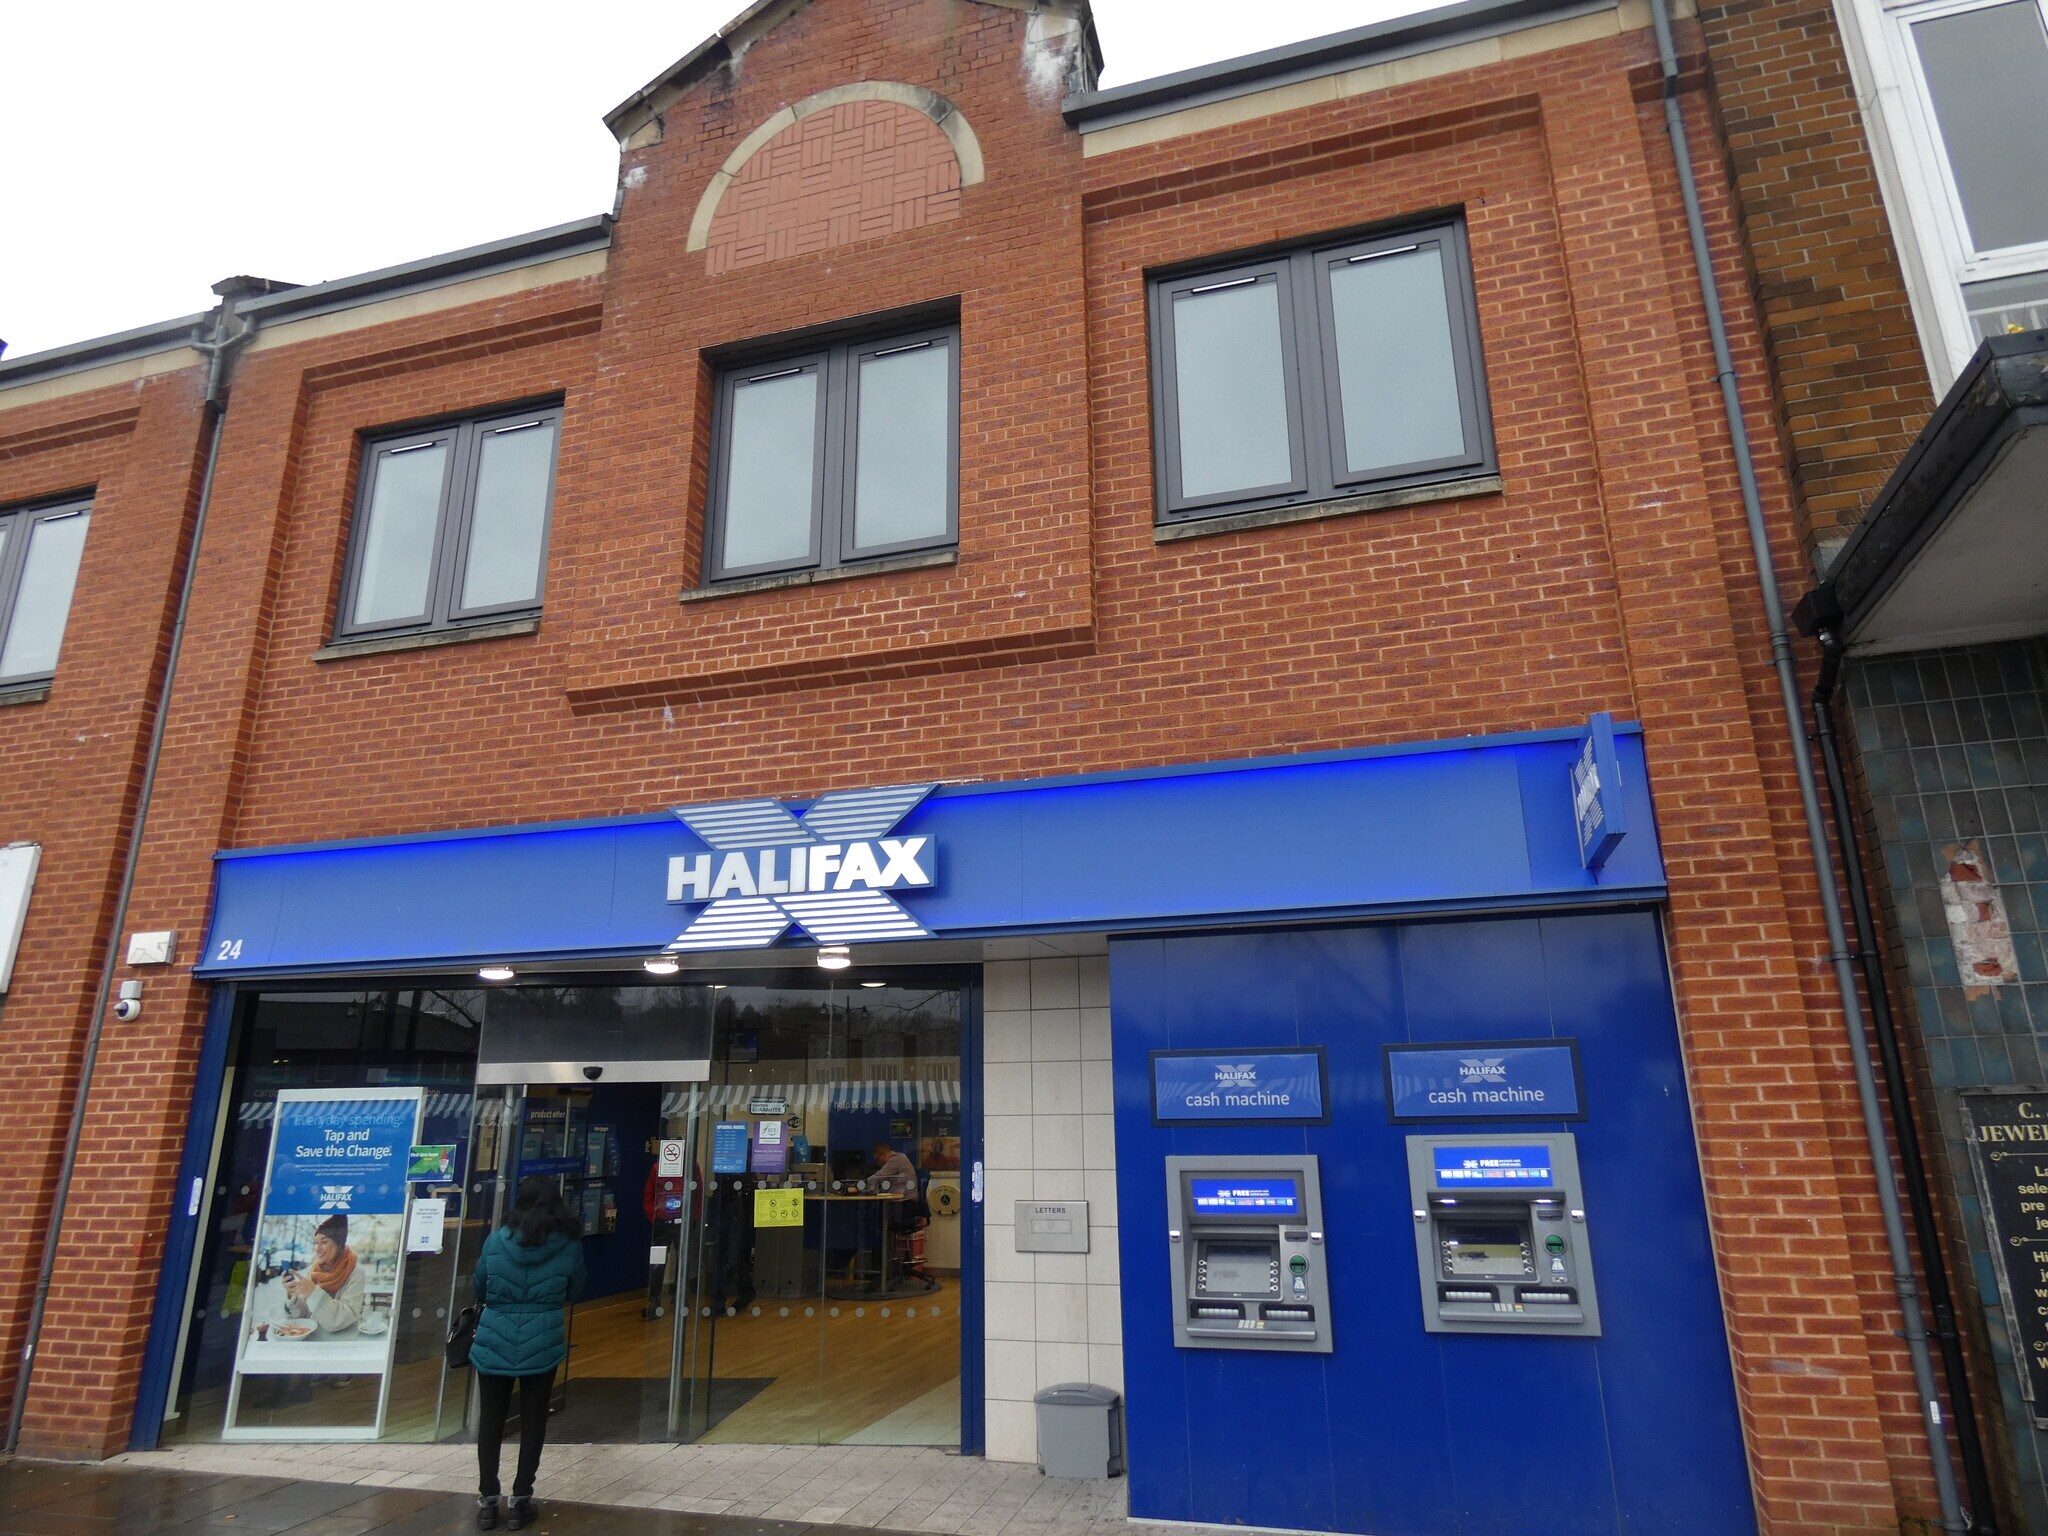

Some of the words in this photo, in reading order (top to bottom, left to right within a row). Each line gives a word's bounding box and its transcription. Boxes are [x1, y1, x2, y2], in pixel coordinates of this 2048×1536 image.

[667, 838, 930, 900] HALIFAX
[217, 939, 243, 961] 24
[1214, 1072, 1257, 1080] HALIFAX
[1459, 1066, 1506, 1075] HALIFAX
[1185, 1092, 1220, 1106] cash
[1225, 1091, 1290, 1106] machine
[1428, 1088, 1467, 1103] cash
[1472, 1086, 1545, 1102] machine
[293, 1114, 346, 1128] Everyday
[348, 1112, 403, 1128] spending.
[324, 1129, 345, 1144] Tap
[347, 1128, 371, 1141] and
[295, 1145, 324, 1157] Save
[325, 1145, 344, 1157] the
[1480, 1159, 1499, 1167] FREE
[320, 1193, 352, 1201] HALIFAX
[1232, 1189, 1250, 1197] FREE
[2020, 1202, 2046, 1214] pre
